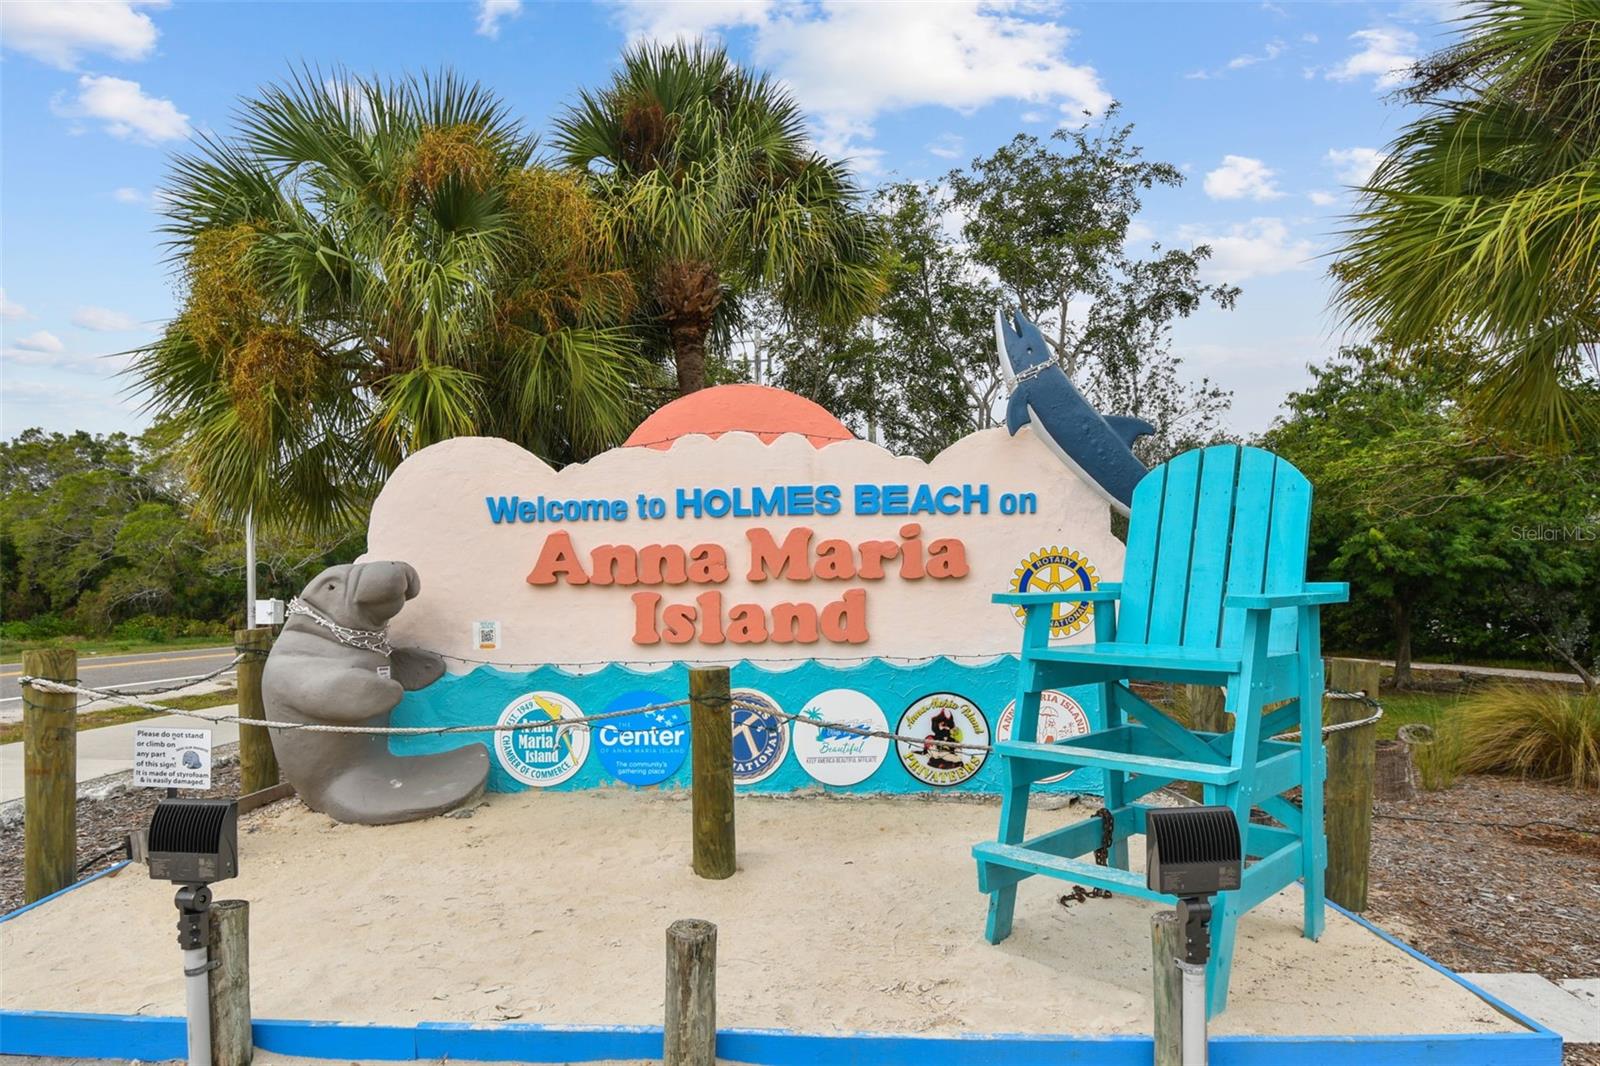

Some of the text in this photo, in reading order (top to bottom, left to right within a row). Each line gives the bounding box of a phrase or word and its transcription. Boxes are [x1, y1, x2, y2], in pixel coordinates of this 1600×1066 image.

[486, 484, 1037, 524] Welcome to HOLMES BEACH on
[526, 523, 970, 585] Anna Maria
[1035, 556, 1075, 568] ROTARY
[631, 588, 870, 645] Island
[1041, 694, 1058, 704] RIA
[1060, 699, 1086, 734] ISLAND
[137, 729, 160, 737] Please
[518, 734, 553, 749] Maria
[599, 724, 685, 747] Center
[503, 735, 571, 779] CHAMBER OF COMMERCE
[525, 750, 559, 763] Island
